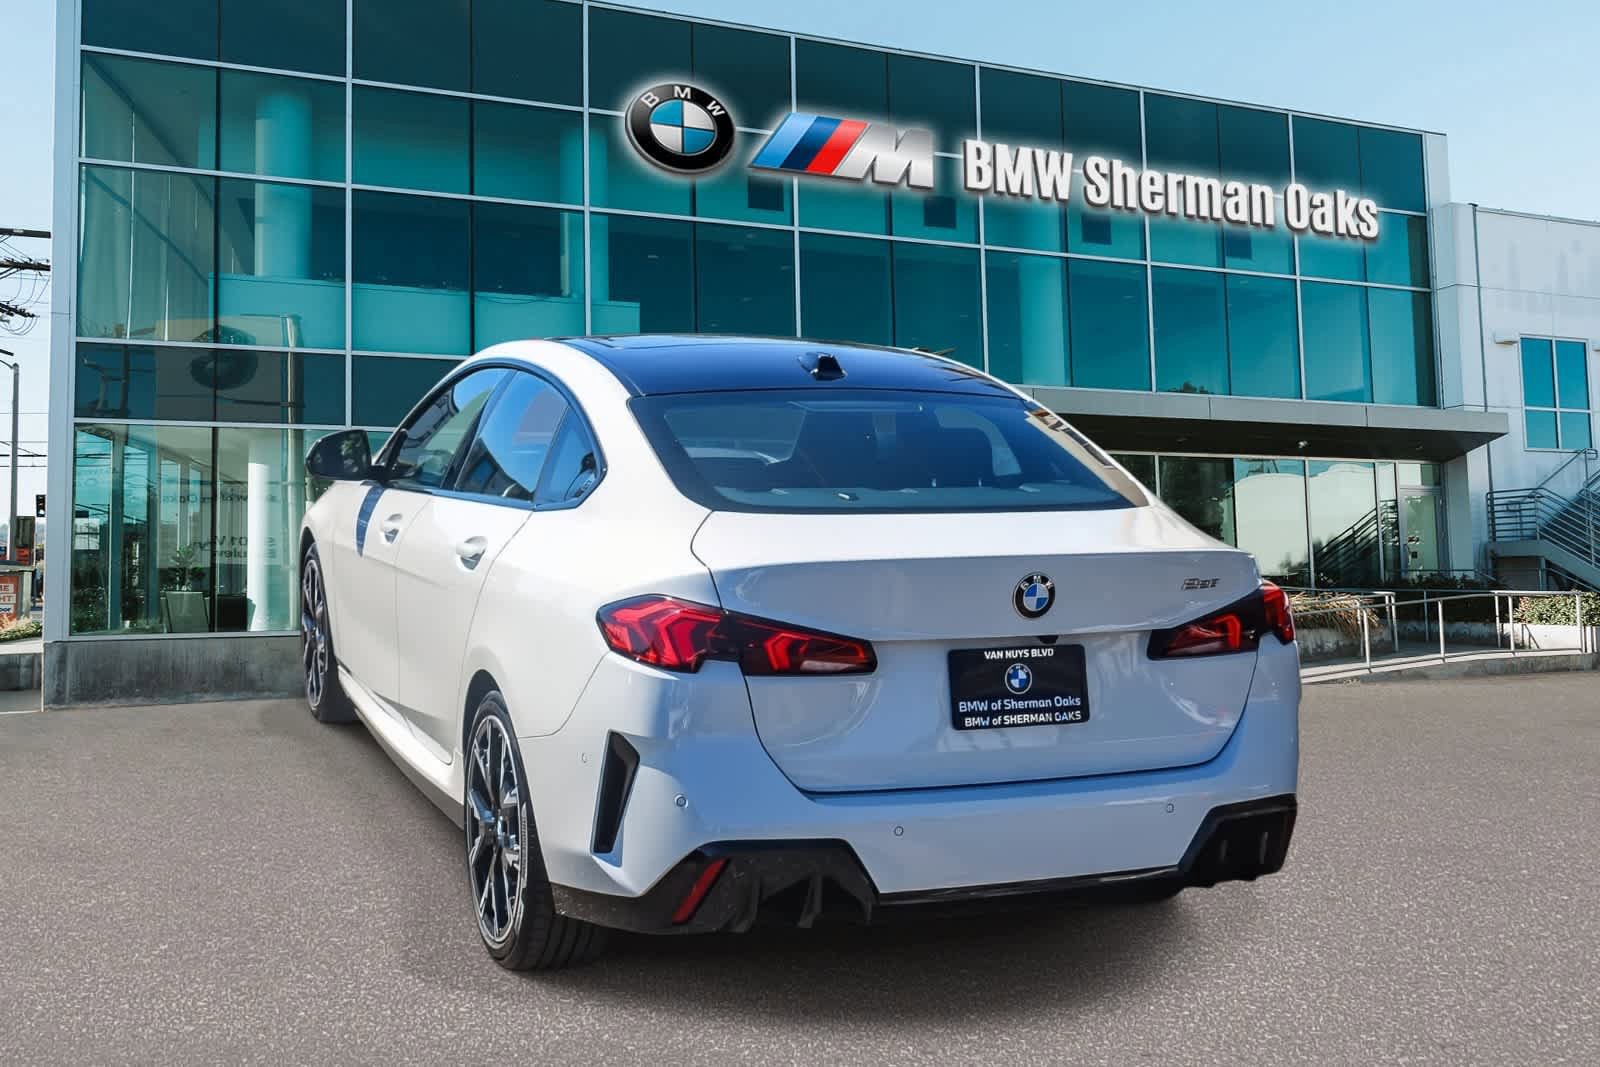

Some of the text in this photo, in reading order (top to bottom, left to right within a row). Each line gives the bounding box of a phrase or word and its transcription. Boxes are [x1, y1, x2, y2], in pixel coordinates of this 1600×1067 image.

[641, 85, 726, 118] BMW
[965, 139, 1379, 240] BMW Sherman Oaks
[984, 647, 1054, 660] VAN NUYS BLVD
[959, 695, 1081, 713] BMW of Sherman Oaks
[964, 710, 1082, 727] BMW of SHERMAN OAKS
